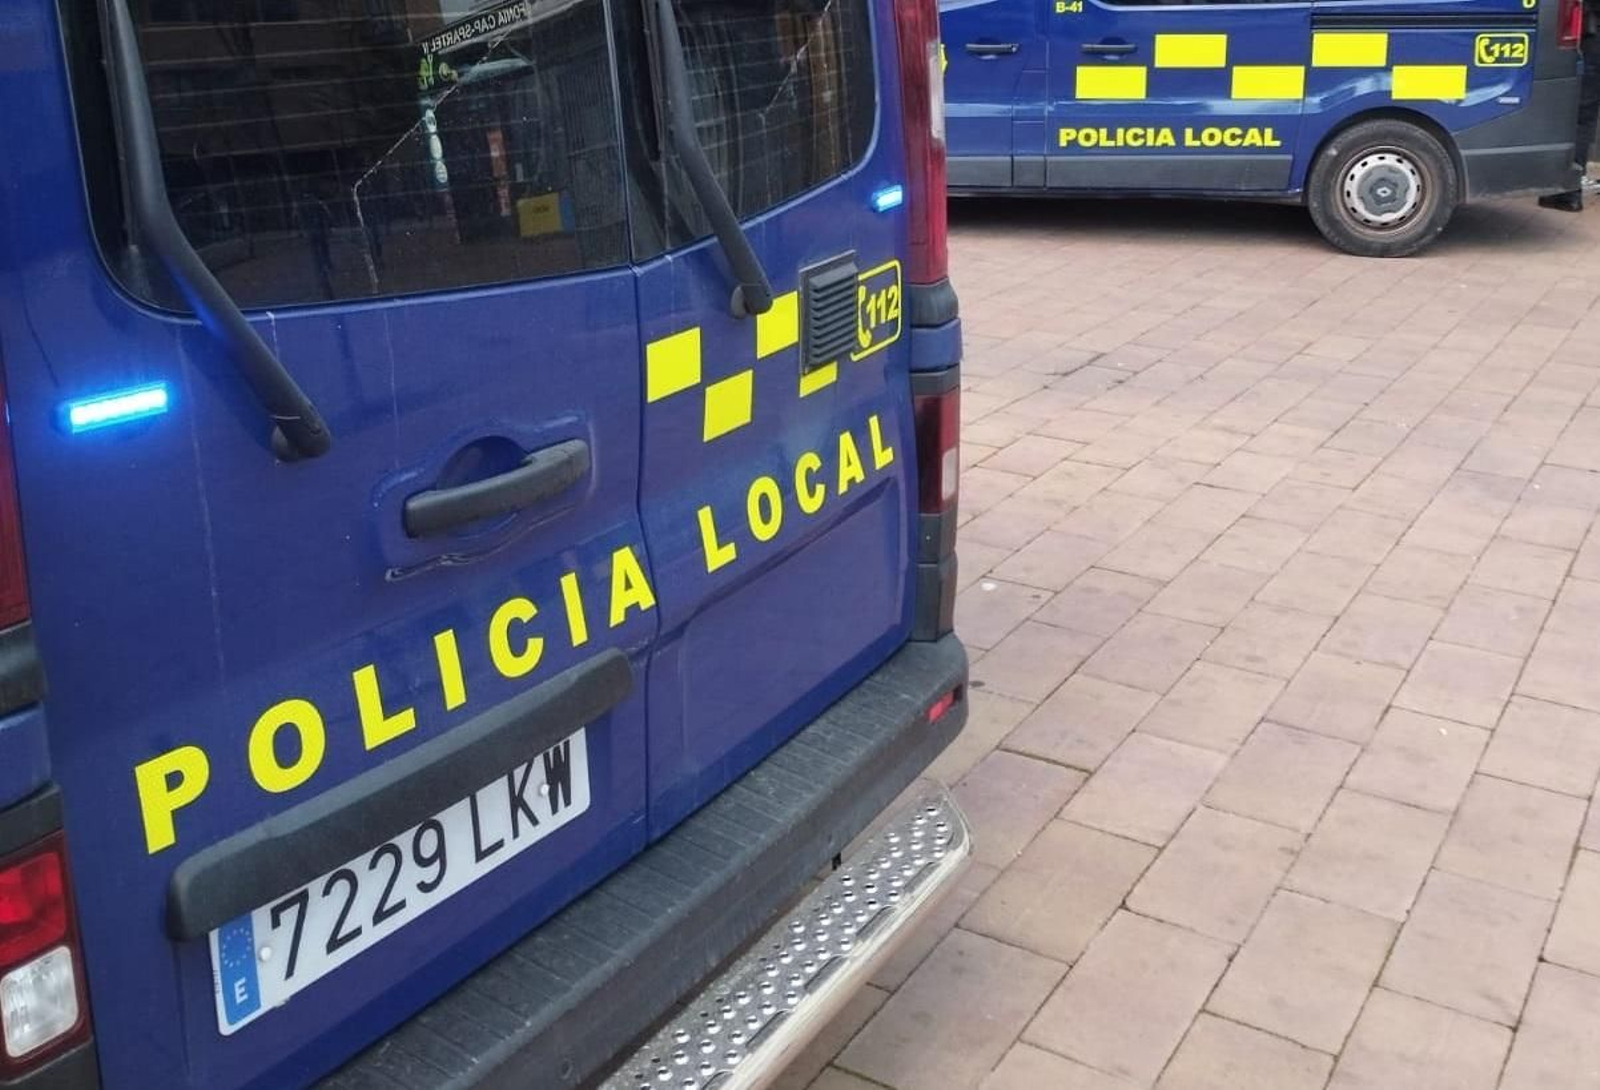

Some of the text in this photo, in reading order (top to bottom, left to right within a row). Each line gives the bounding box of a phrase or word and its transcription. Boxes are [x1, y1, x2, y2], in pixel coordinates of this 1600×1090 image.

[1055, 1, 1083, 13] B-41
[1490, 43, 1524, 58] 112
[1058, 127, 1282, 148] POLICIA LOCAL
[866, 285, 898, 329] 112
[134, 413, 896, 853] POLICIA LOCAL
[270, 739, 572, 981] 7229 LKW
[233, 977, 249, 1005] E
